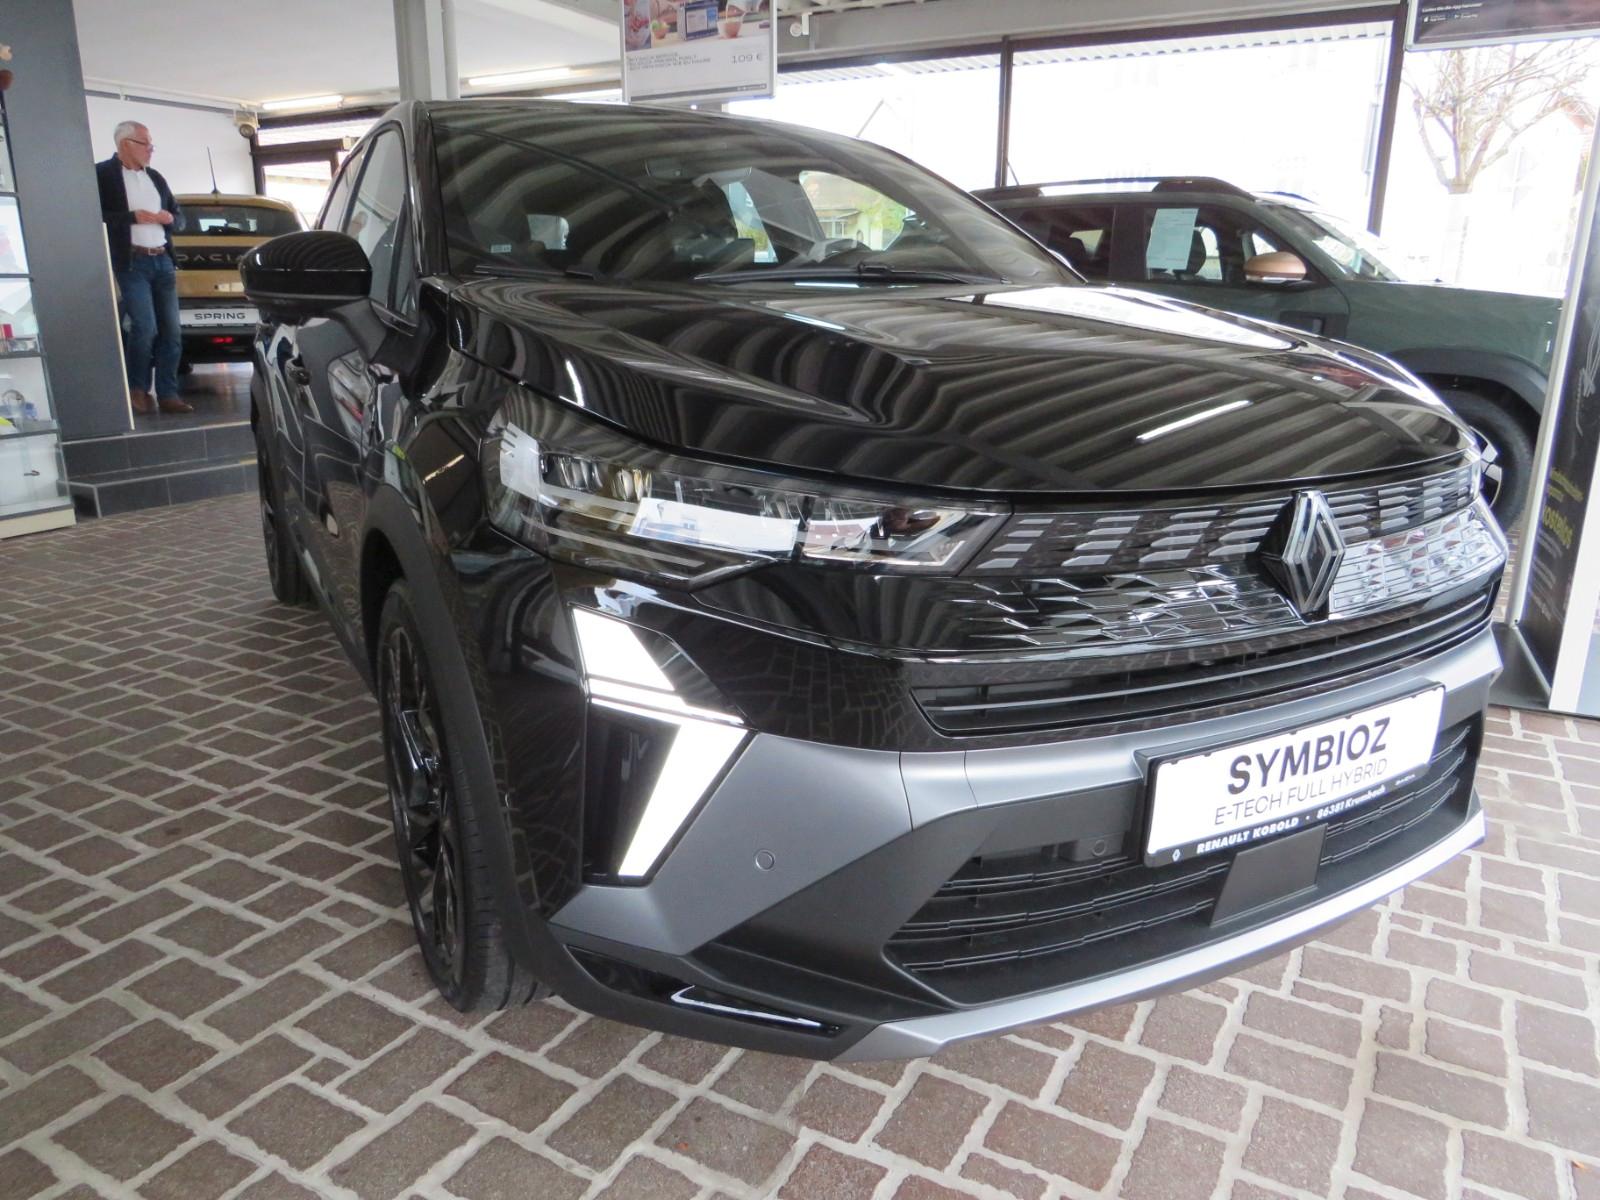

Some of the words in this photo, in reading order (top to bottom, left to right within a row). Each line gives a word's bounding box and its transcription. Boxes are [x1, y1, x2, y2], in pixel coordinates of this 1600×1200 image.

[731, 54, 753, 64] 109
[194, 312, 246, 320] SPRING
[1227, 717, 1391, 795] SYMBIOZ
[1214, 790, 1283, 826] E-TECH
[1287, 781, 1327, 803] FULL
[1331, 758, 1389, 791] HYBRID
[1196, 831, 1250, 855] RENAULT
[1252, 816, 1300, 839] KOBOLD
[1316, 803, 1345, 820] 86381
